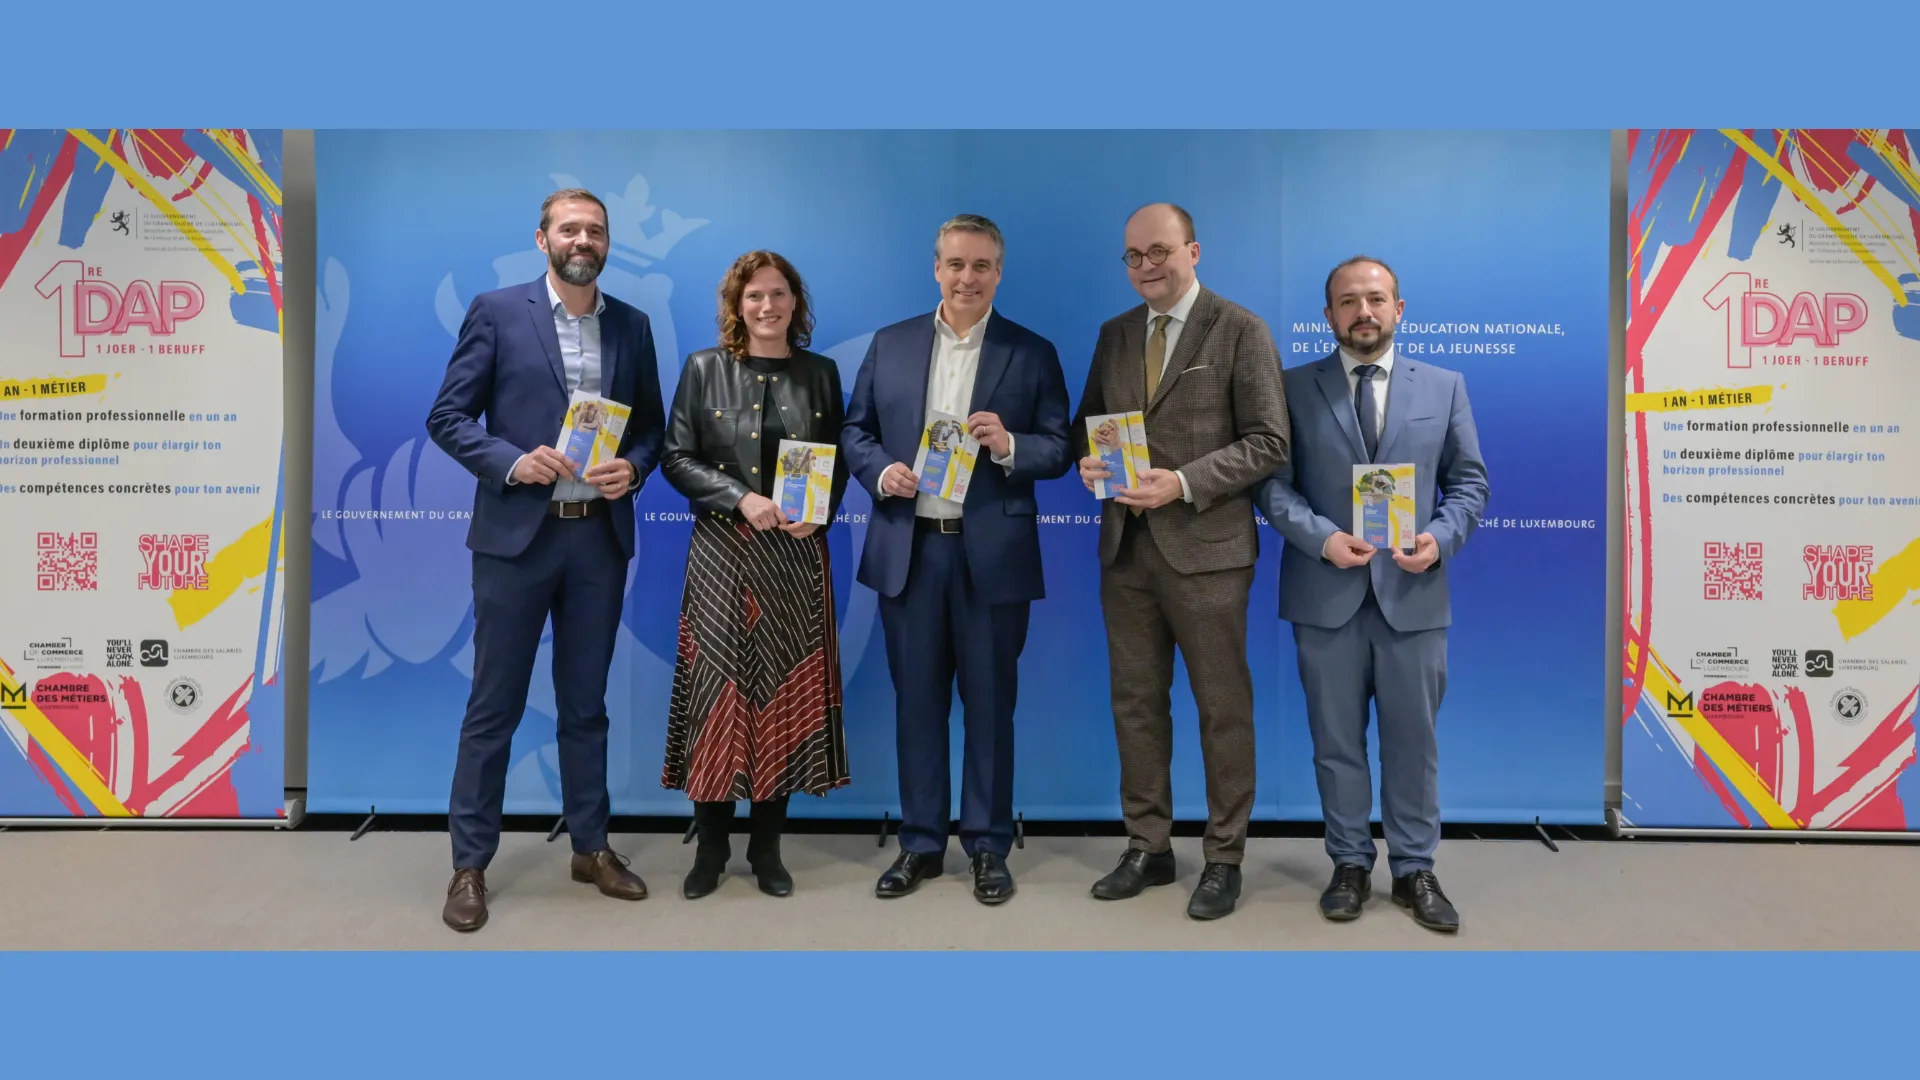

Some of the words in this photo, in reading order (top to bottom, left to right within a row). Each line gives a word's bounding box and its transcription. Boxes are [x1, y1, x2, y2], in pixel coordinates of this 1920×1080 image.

[74, 280, 204, 336] DAP
[1741, 292, 1868, 348] DAP
[1485, 323, 1565, 336] NATIONALE,
[96, 344, 102, 354] 1
[106, 344, 136, 354] JOER
[149, 344, 154, 354] 1
[159, 344, 206, 354] BERUFF
[1292, 342, 1309, 352] DE
[1408, 343, 1425, 353] DE
[1430, 343, 1445, 354] LA
[1449, 343, 1515, 354] JEUNESSE
[1763, 356, 1767, 365] 1
[1772, 356, 1801, 365] JOER
[1814, 356, 1818, 365] 1
[1823, 356, 1869, 366] BERUFF
[4, 386, 20, 396] AN
[32, 384, 36, 394] 1
[40, 381, 86, 394] MÉTIER
[1664, 397, 1667, 407] 1
[1672, 396, 1687, 407] AN
[1700, 395, 1704, 405] 1
[1708, 392, 1752, 405] MÉTIER
[20, 410, 82, 421] formation
[86, 410, 186, 423] professionnelle
[189, 413, 202, 422] en
[206, 413, 220, 422] un
[224, 414, 237, 422] an
[1664, 422, 1684, 431] Une
[1687, 420, 1748, 432] formation
[1752, 421, 1849, 434] professionnelle
[1853, 425, 1866, 433] en
[1870, 425, 1883, 433] un
[1887, 425, 1900, 433] an
[14, 438, 74, 449] deuxième
[79, 438, 130, 452] diplôme
[134, 441, 158, 451] pour
[162, 439, 200, 452] élargir
[203, 440, 221, 450] ton
[41, 455, 119, 467] professionnel
[1664, 451, 1676, 459] Un
[1680, 449, 1741, 460] deuxième
[1744, 449, 1795, 463] diplôme
[1799, 452, 1823, 462] pour
[1826, 451, 1863, 463] élargir
[1867, 452, 1885, 461] ton
[1663, 465, 1705, 475] horizon
[1708, 466, 1784, 478] professionnel
[20, 482, 104, 495] compétences
[108, 482, 171, 494] concrètes
[175, 485, 200, 496] pour
[203, 484, 222, 494] ton
[226, 484, 261, 494] avenir
[1663, 494, 1682, 503] Des
[1686, 492, 1770, 506] compétences
[1774, 493, 1835, 505] concrètes
[1839, 497, 1864, 506] pour
[1868, 496, 1885, 505] ton
[322, 510, 332, 519] LE
[336, 510, 426, 519] GOUVERNEMENT
[429, 511, 444, 519] DU
[645, 513, 656, 521] LE
[854, 514, 867, 523] DE
[1075, 515, 1090, 524] DU
[1503, 519, 1516, 528] DE
[1520, 519, 1595, 528] LUXEMBOURG
[139, 534, 209, 552] SHAPE
[1803, 544, 1873, 564] SHAPE
[142, 550, 205, 576] YOUR
[1806, 561, 1870, 586] YOUR
[138, 573, 209, 590] FUTURE
[1803, 584, 1873, 601] FUTURE
[37, 684, 89, 692] CHAMBRE
[61, 693, 106, 702] MÉTIERS
[1703, 694, 1755, 702] CHAMBRE
